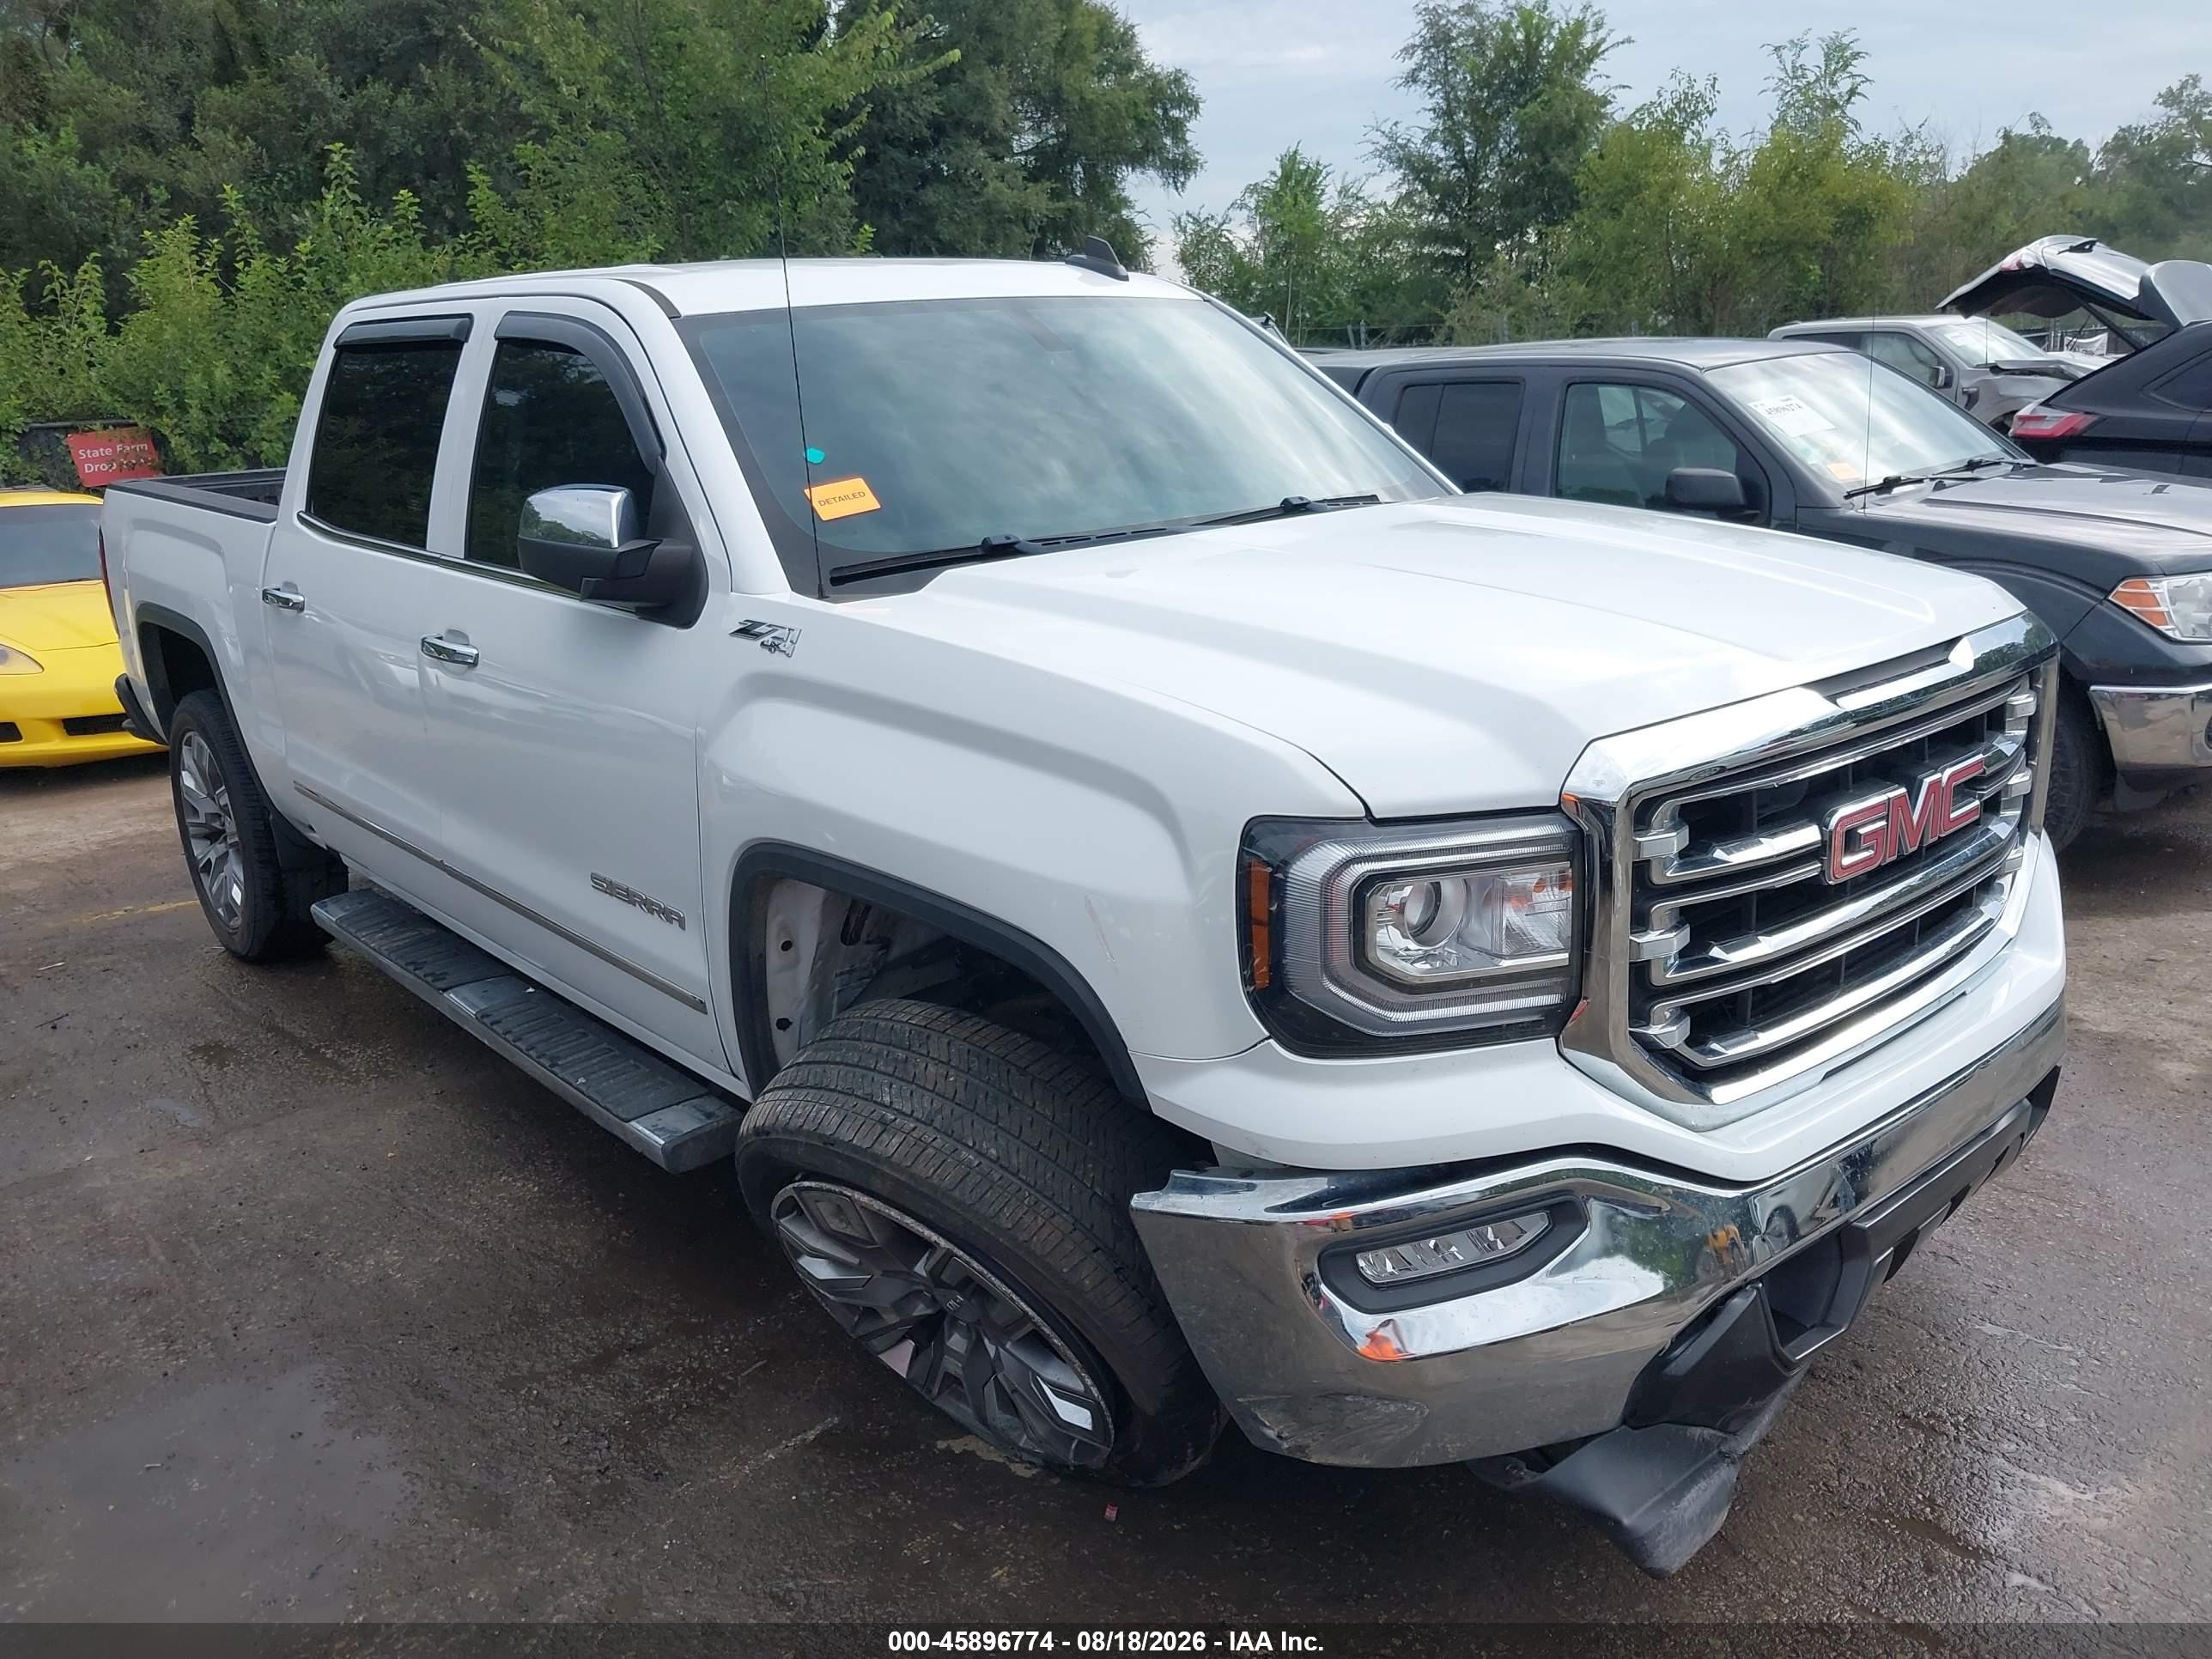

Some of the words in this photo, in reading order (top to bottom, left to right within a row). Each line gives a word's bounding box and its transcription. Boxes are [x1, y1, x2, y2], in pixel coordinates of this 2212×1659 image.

[78, 447, 112, 459] State
[116, 443, 149, 455] Farm
[817, 491, 866, 507] DETAILED
[728, 619, 802, 645] Z71
[1824, 754, 1986, 885] GMC
[590, 872, 686, 931] SIERRA
